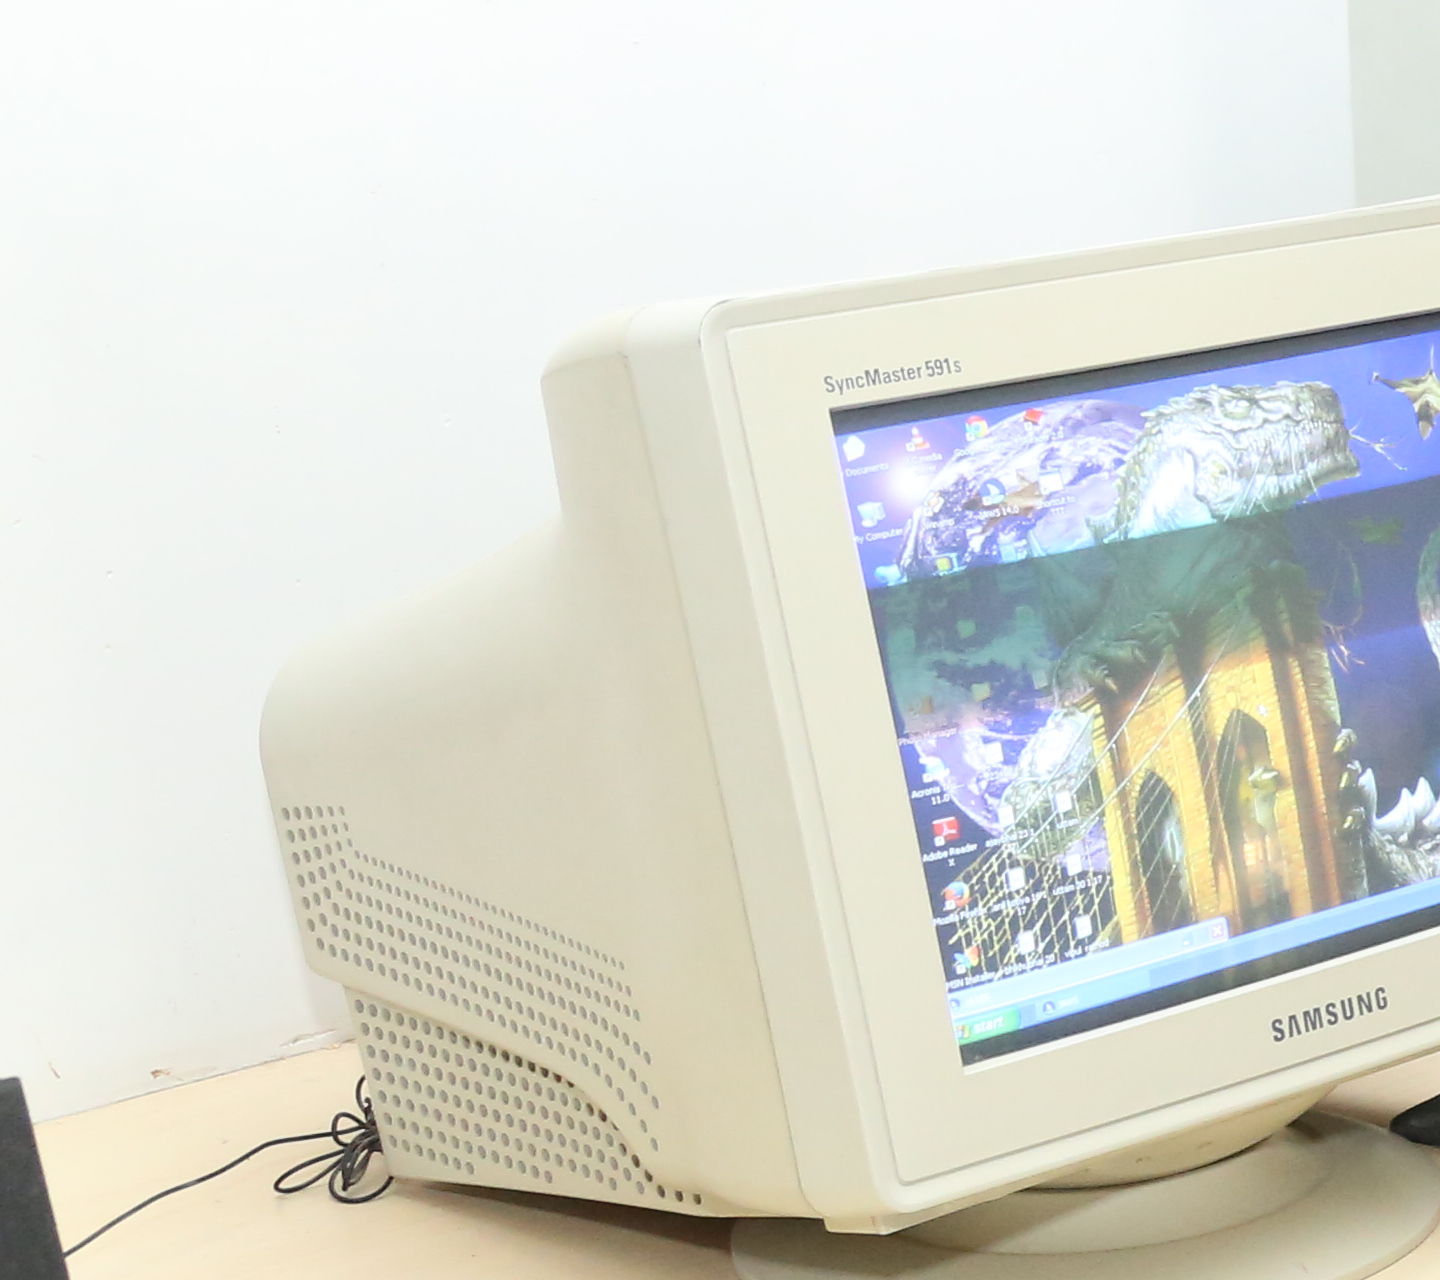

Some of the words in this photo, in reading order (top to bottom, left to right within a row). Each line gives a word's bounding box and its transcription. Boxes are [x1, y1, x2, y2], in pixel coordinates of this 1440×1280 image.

[823, 364, 922, 395] SyncMaster
[924, 356, 963, 379] 591s
[845, 461, 889, 478] Documents
[866, 526, 904, 542] Computer
[931, 795, 950, 806] 11.0
[922, 848, 948, 863] Adobe
[949, 842, 978, 857] Reader
[1270, 985, 1390, 1044] SAMSUNG
[974, 1016, 1004, 1034] start
